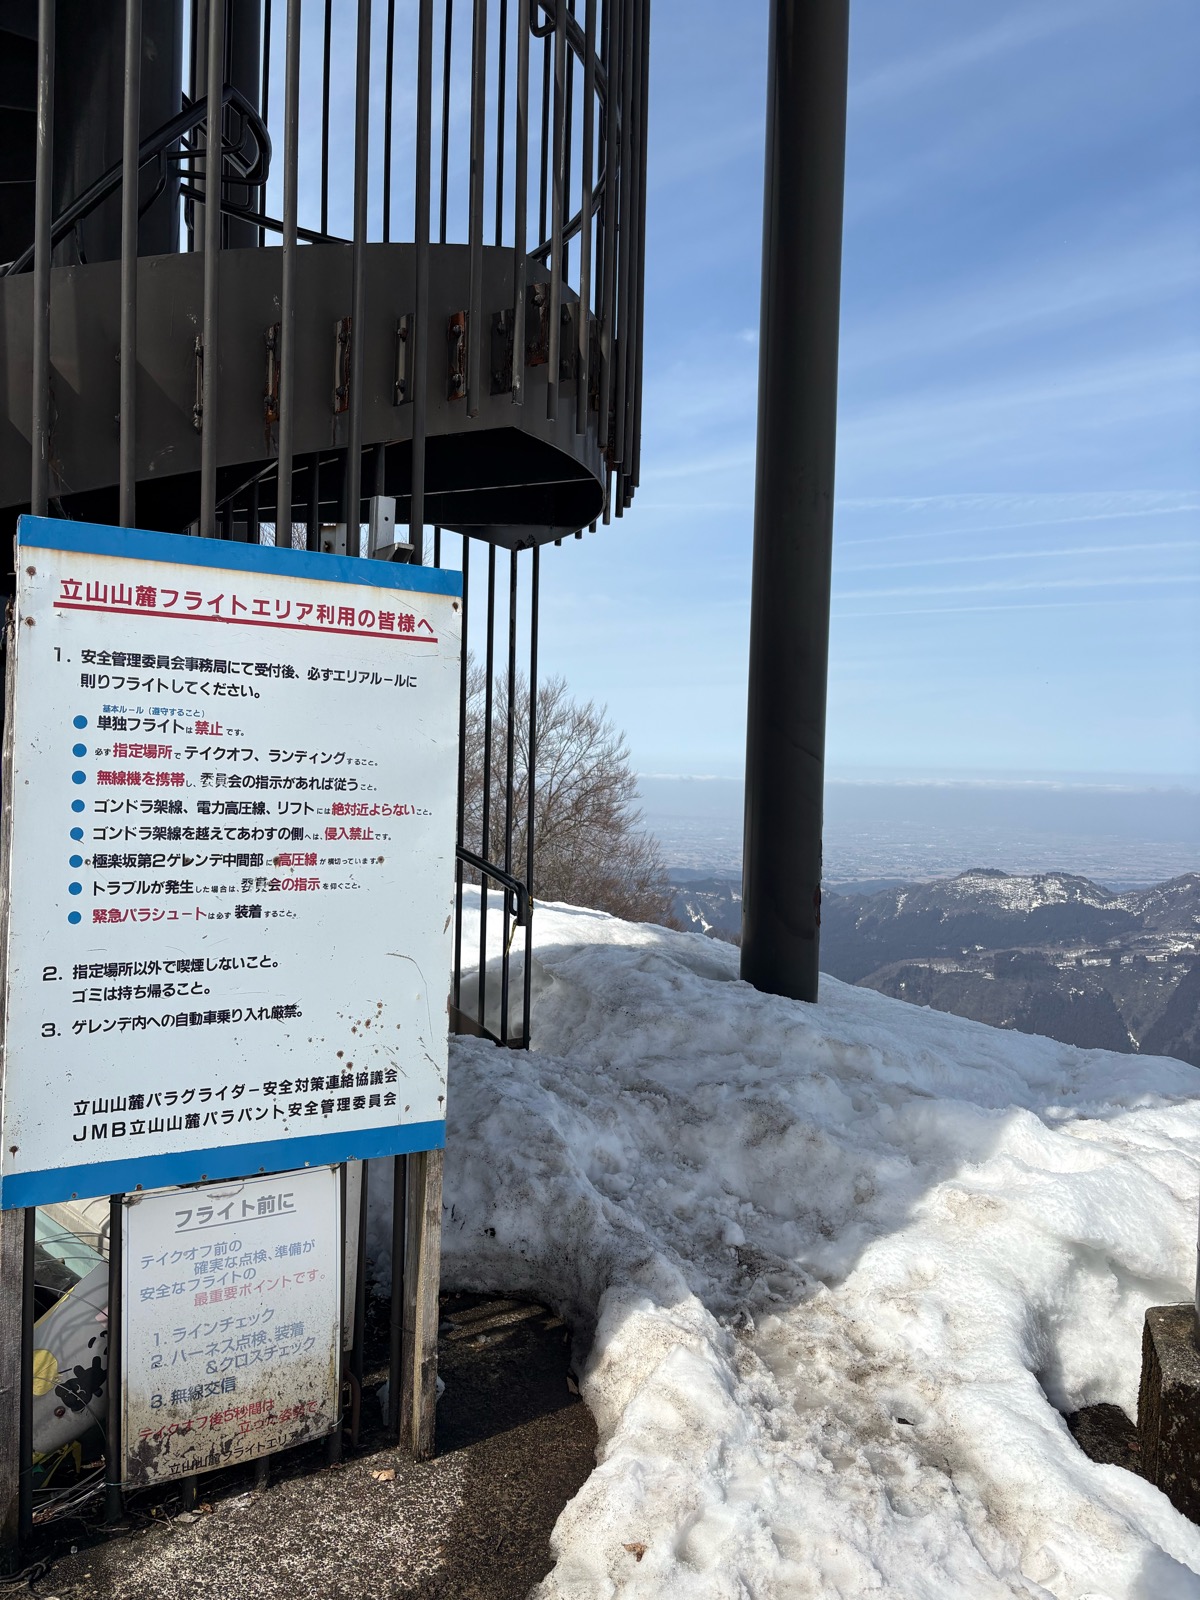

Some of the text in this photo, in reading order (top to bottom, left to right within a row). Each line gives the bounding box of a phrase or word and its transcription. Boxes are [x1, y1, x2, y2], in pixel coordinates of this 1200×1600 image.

[60, 578, 434, 634] 立山山麓フライトエリア利用の皆様へ
[54, 647, 417, 688] 1. 安全管理委員会事務局にて受付後、必ずエリアルールに
[80, 673, 260, 698] 則りフライトしてください。
[42, 955, 279, 981] 2. 指定場所以外で喫煙しないこと。
[72, 981, 211, 1003] ゴミは持ち帰ること。
[41, 1004, 303, 1037] 3. ゲレンデ内への自動車乗り入れ厳禁。
[73, 1068, 398, 1117] 立山山麓パラグライダー安全対策連絡協議会
[175, 1193, 294, 1228] フライト前に
[141, 1240, 242, 1269] テイクオフ前の
[194, 1239, 315, 1276] 確実な点検、準備が
[140, 1267, 256, 1302] 安全なフライトの
[194, 1269, 326, 1307] 最重要ポイントです。
[153, 1308, 275, 1347] 1. ラインチェック
[171, 1321, 305, 1366] ハーネス点検、装着
[171, 1376, 236, 1406] 無線交信
